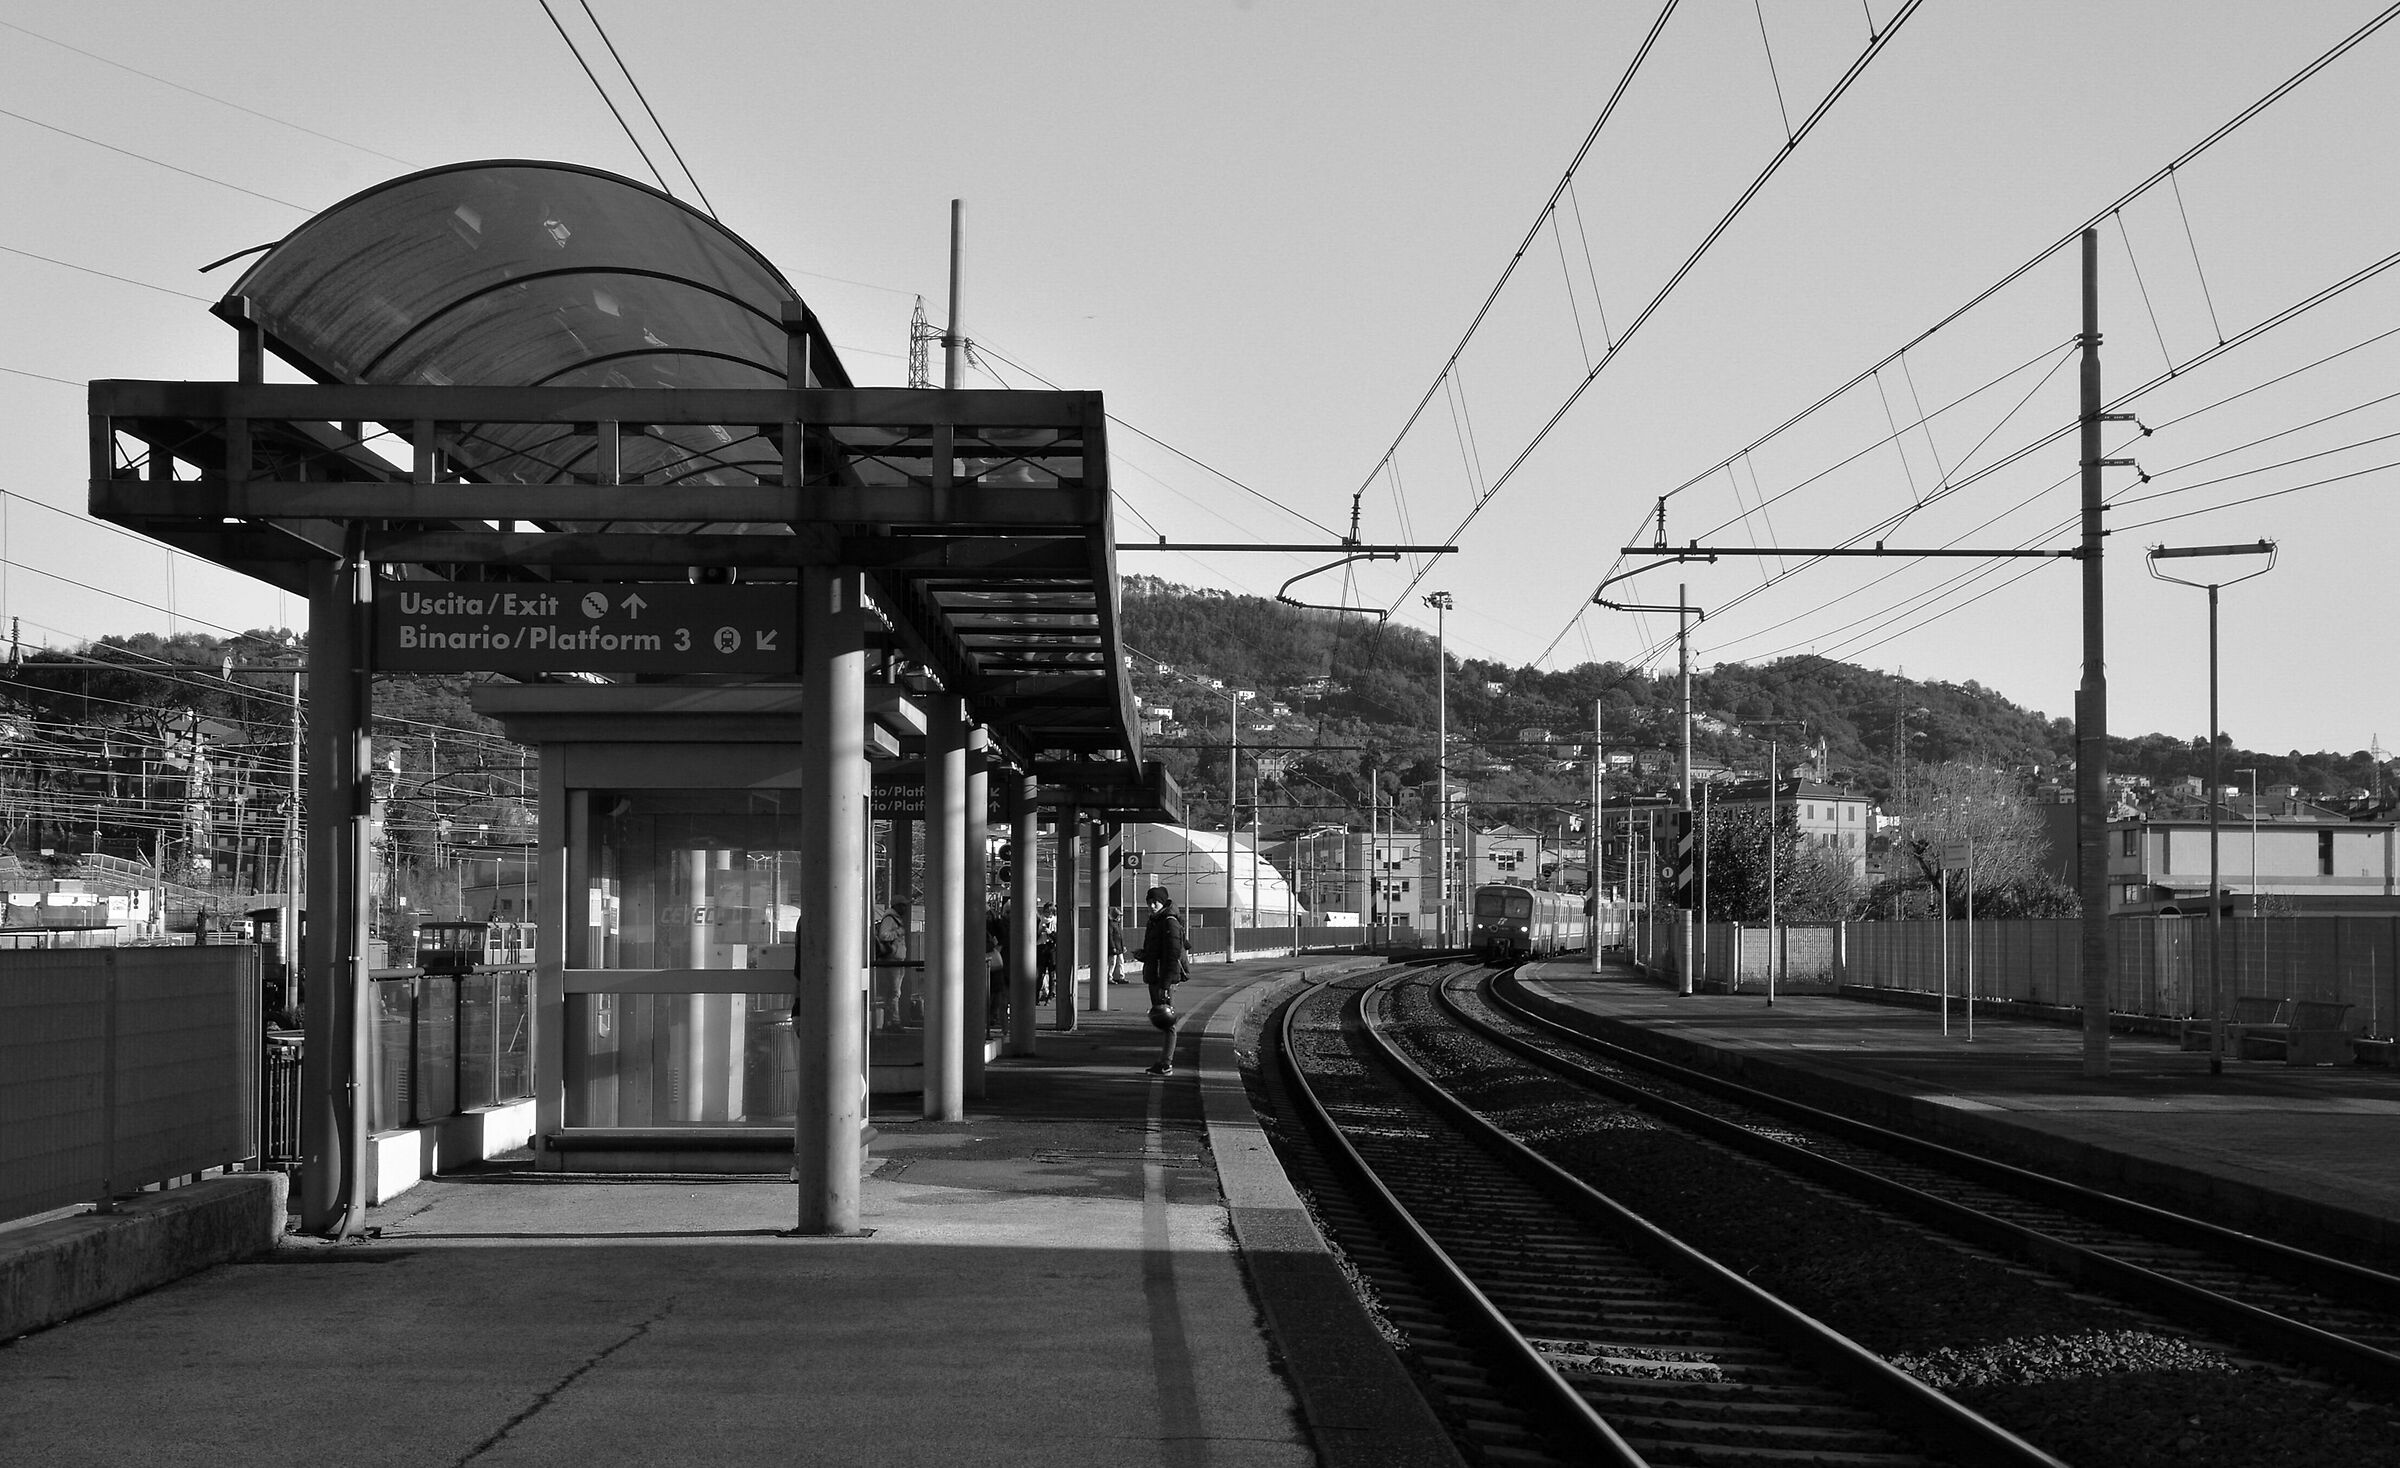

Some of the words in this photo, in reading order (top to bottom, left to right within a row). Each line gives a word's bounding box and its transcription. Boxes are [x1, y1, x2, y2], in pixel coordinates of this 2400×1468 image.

[400, 591, 559, 617] Uscita/Exit
[399, 623, 661, 651] Binario/Platform
[673, 627, 692, 652] 3
[871, 785, 926, 797] io/Platf
[871, 798, 926, 811] io/Platf
